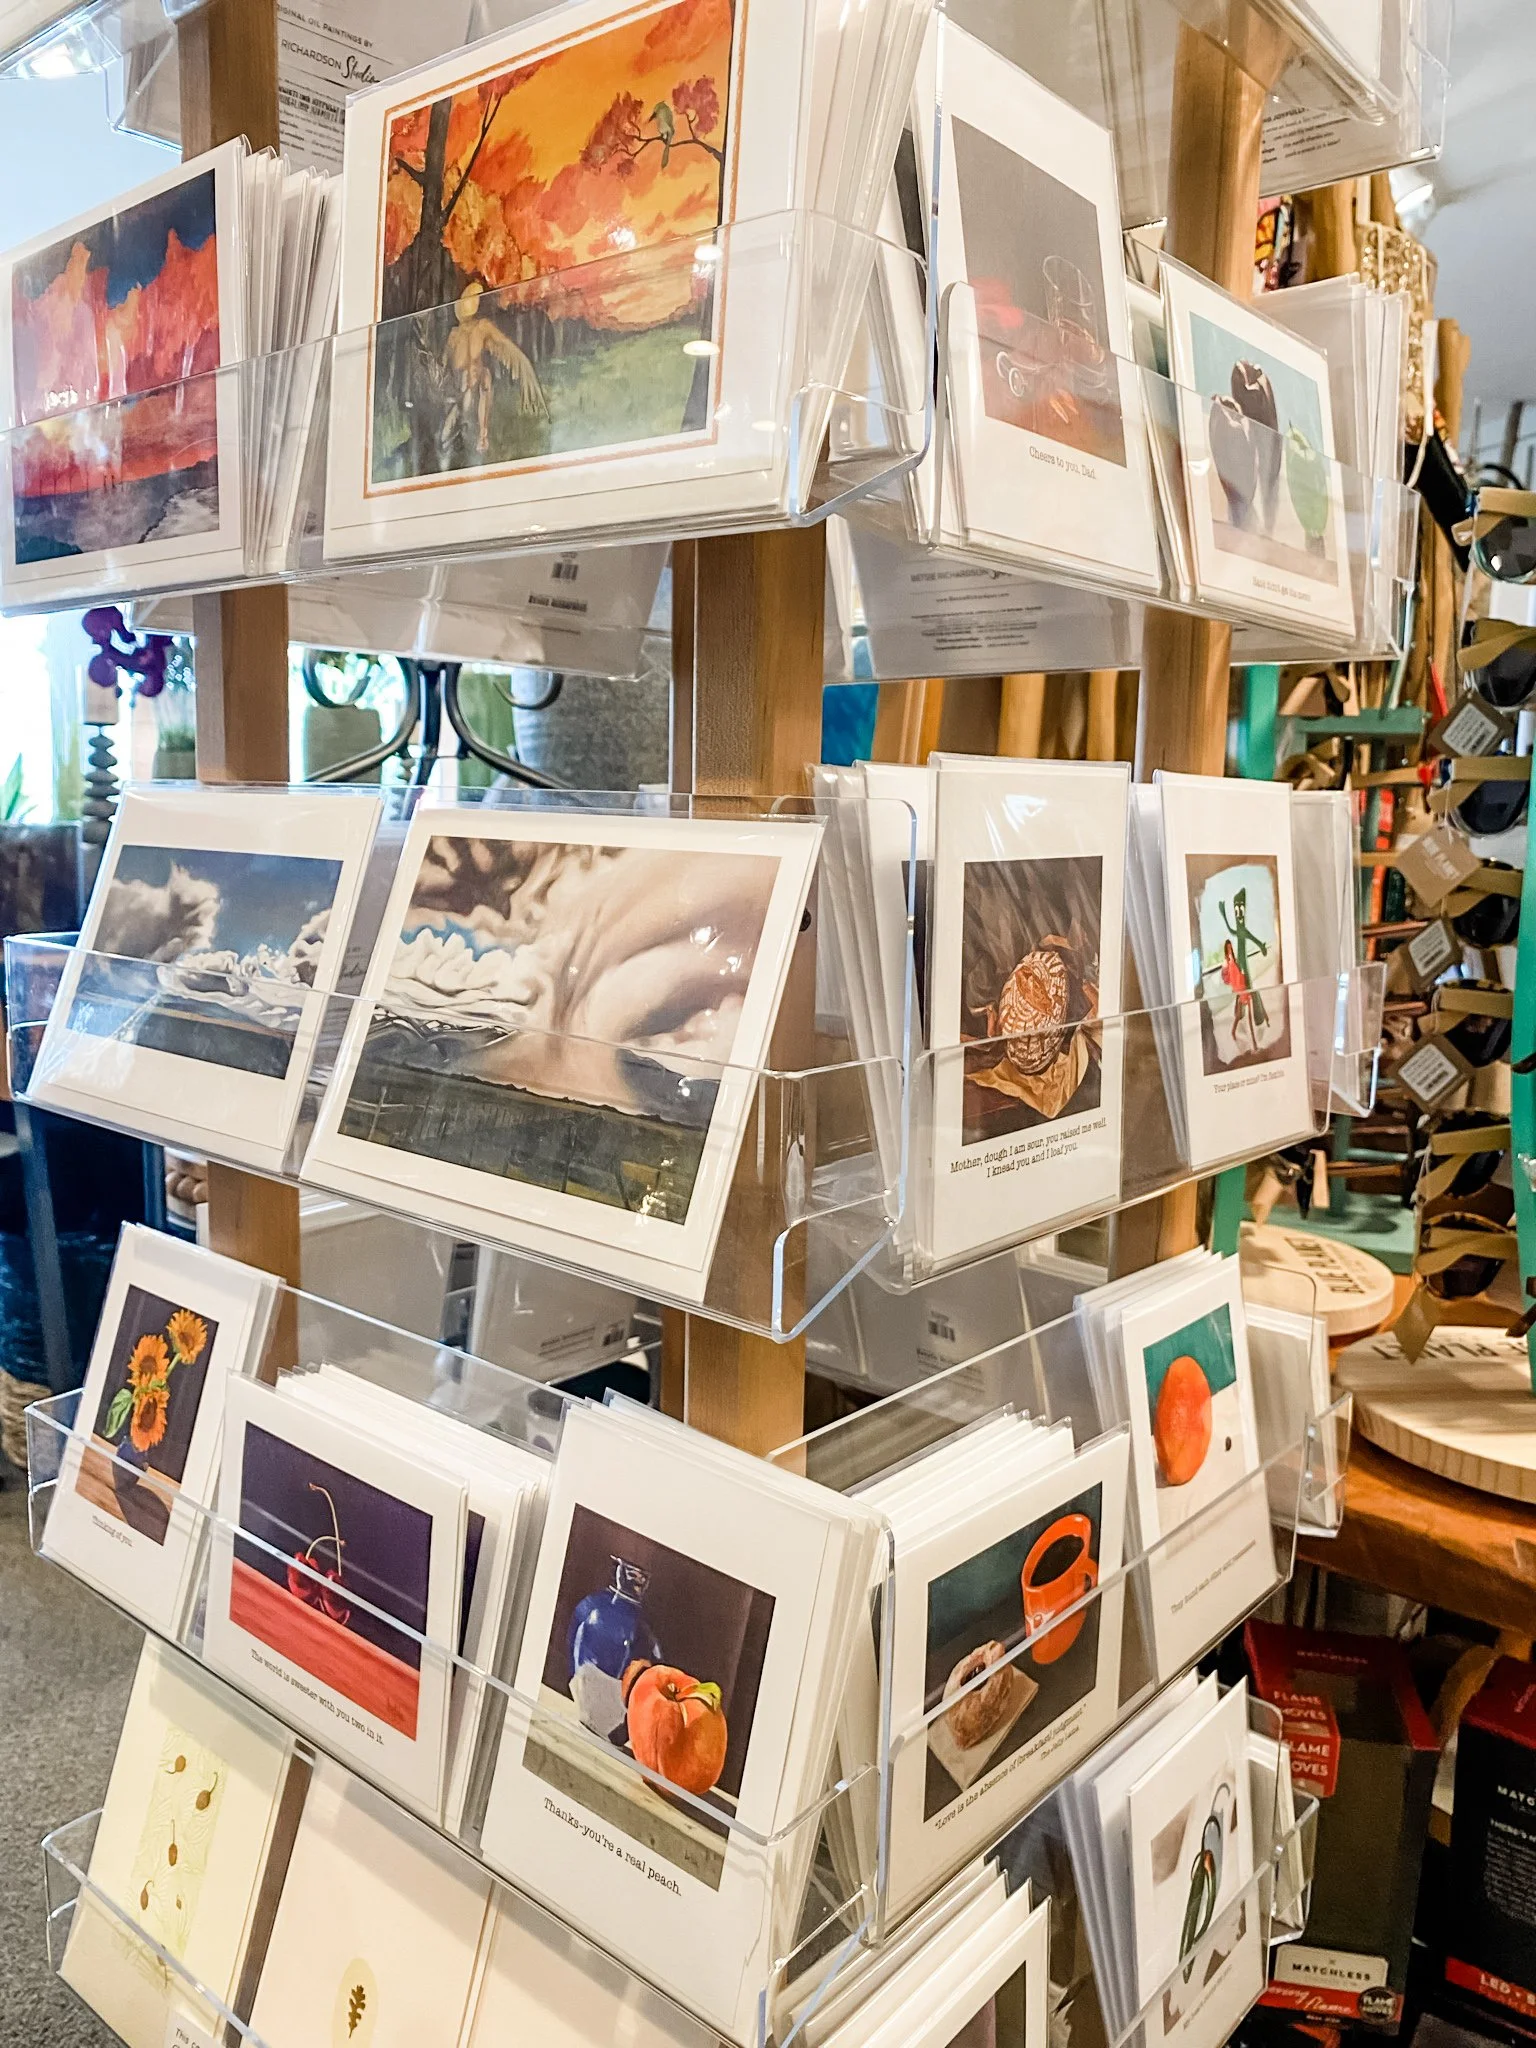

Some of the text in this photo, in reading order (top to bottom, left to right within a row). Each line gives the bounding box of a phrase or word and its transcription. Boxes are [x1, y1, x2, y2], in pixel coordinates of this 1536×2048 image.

[308, 17, 321, 28] OIL
[322, 23, 362, 45] PAINTINGS
[363, 40, 374, 48] BY
[281, 38, 342, 70] RICHARDSON
[1029, 446, 1056, 465] Cheers
[1056, 456, 1064, 468] to
[1081, 464, 1096, 479] Dad.
[950, 1158, 983, 1174] Mother,
[984, 1148, 1008, 1164] dough
[1014, 1144, 1026, 1156] am
[1046, 1134, 1059, 1148] you
[1060, 1126, 1081, 1141] raised
[1081, 1123, 1092, 1135] me
[991, 1160, 1016, 1177] knead
[1016, 1156, 1030, 1170] you
[1031, 1152, 1045, 1164] and
[1050, 1146, 1063, 1159] loaf
[251, 1648, 264, 1664] The
[264, 1656, 283, 1678] world
[283, 1671, 290, 1683] is
[290, 1678, 318, 1701] sweeter
[319, 1695, 335, 1713] with
[336, 1707, 350, 1723] you
[351, 1716, 365, 1733] two
[366, 1727, 375, 1739] in
[1273, 1690, 1321, 1705] FLAME
[1289, 1740, 1331, 1757] LAME
[1291, 1760, 1329, 1776] OVES
[957, 1803, 965, 1815] is
[965, 1792, 979, 1807] the
[979, 1768, 1009, 1796] absence
[543, 1797, 682, 1896] Thanks-you're a real peach.
[1292, 1963, 1371, 1981] MATCHLESS
